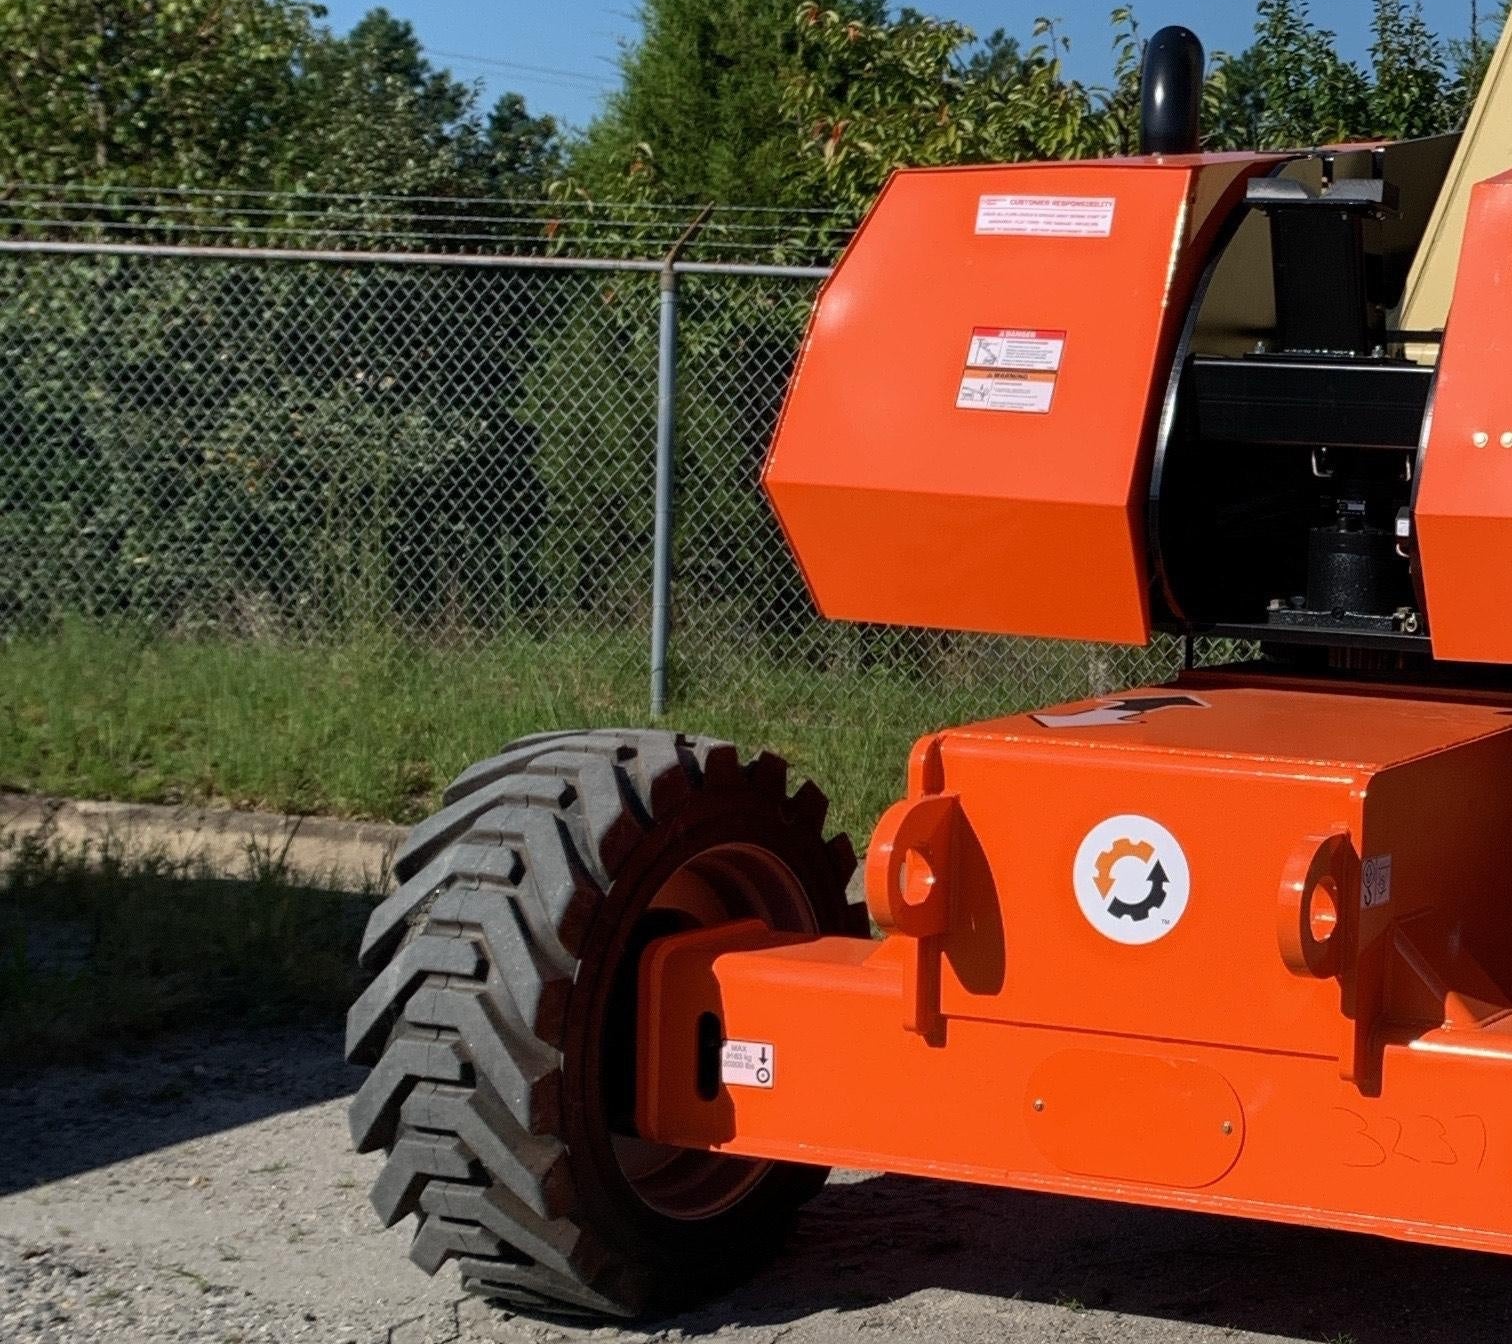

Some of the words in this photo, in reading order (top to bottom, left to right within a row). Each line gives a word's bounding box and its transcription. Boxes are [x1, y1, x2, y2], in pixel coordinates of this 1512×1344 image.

[1006, 330, 1037, 338] DANGER
[994, 372, 1029, 380] WARNING
[1330, 1106, 1487, 1173] 3237
